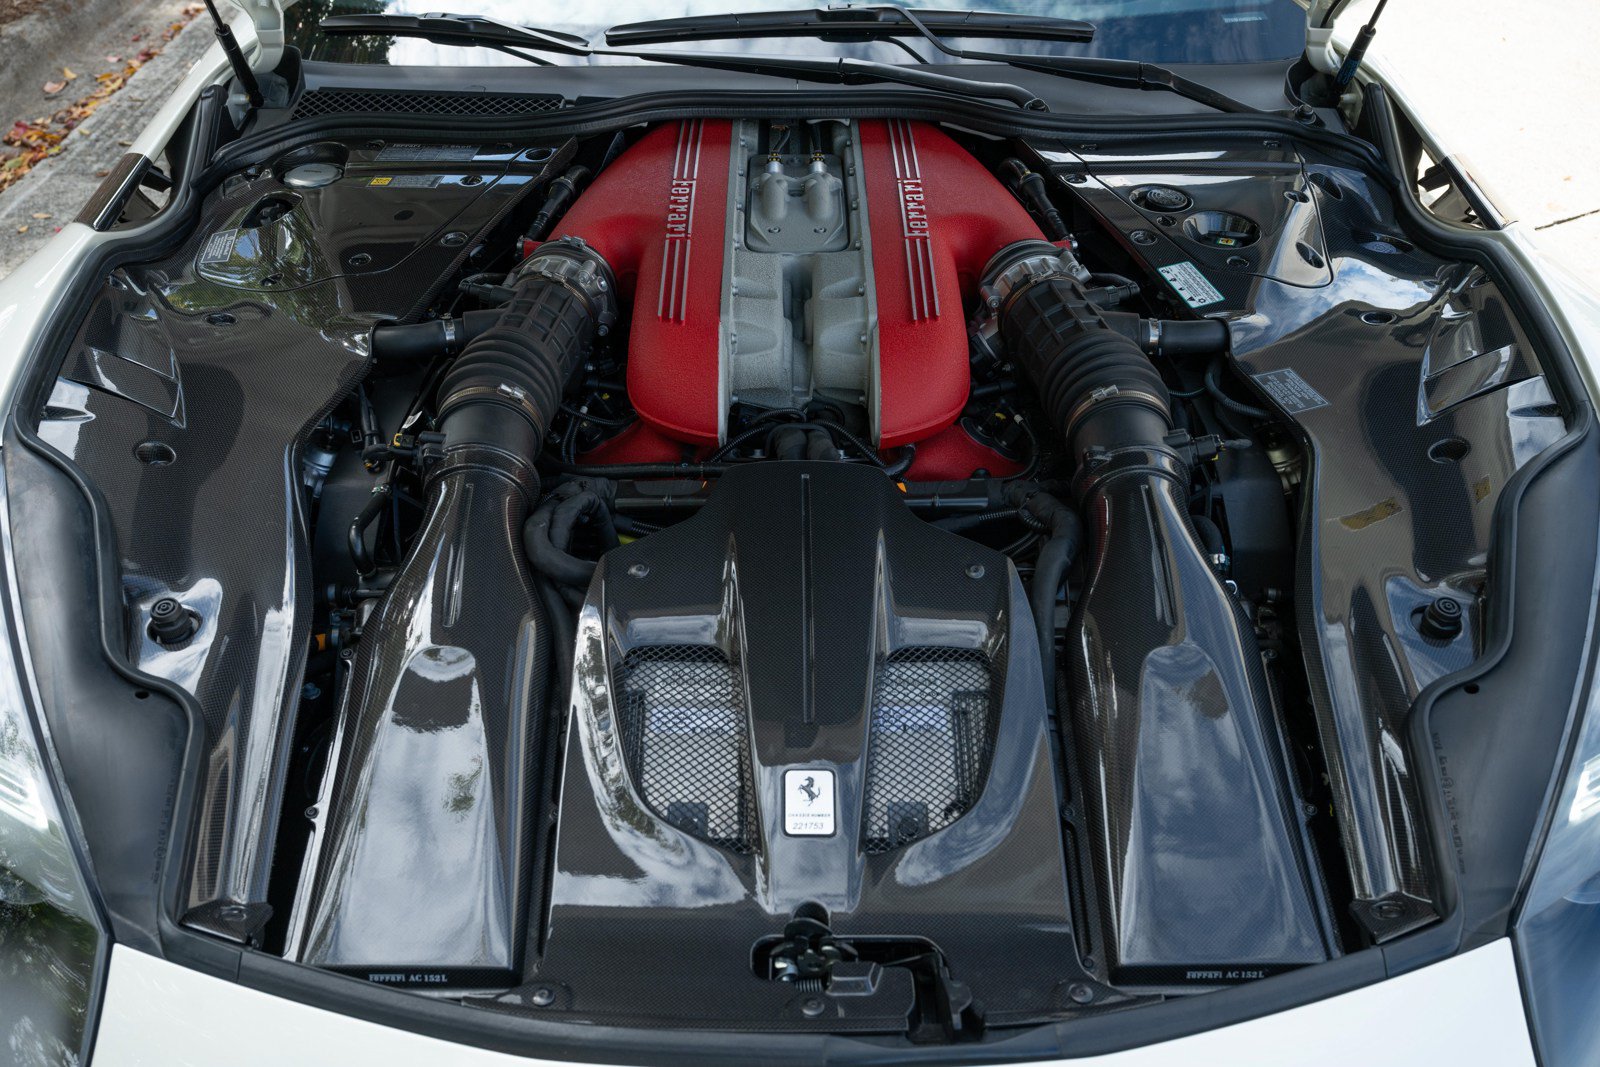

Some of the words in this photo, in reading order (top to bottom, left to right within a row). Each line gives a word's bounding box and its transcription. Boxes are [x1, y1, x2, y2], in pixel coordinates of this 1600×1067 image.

[665, 179, 697, 239] Ferrari
[897, 179, 930, 238] Ferrari
[792, 821, 824, 830] 221753
[409, 974, 422, 982] AC
[1226, 970, 1239, 979] AC
